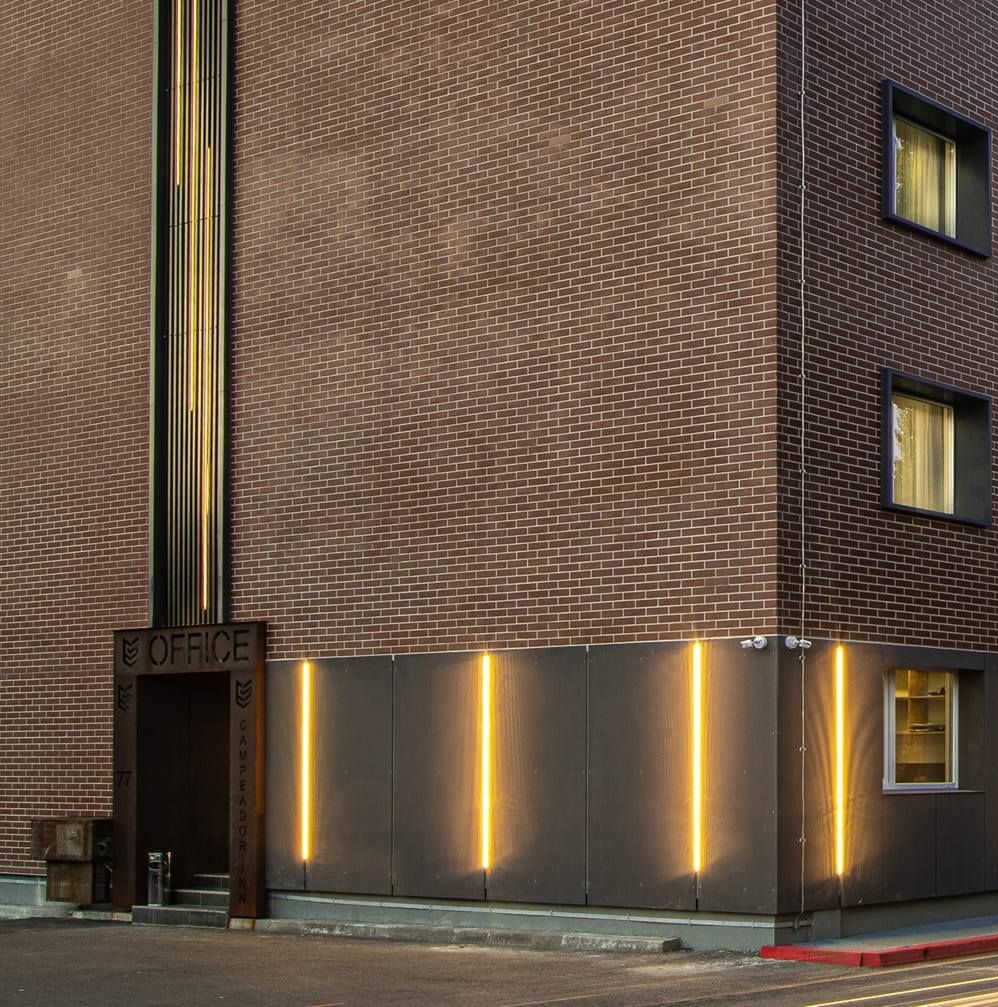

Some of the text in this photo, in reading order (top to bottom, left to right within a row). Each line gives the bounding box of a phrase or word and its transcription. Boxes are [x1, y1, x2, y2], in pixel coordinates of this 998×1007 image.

[150, 630, 249, 666] OFFICE
[116, 771, 132, 787] 77
[239, 720, 247, 851] CAMPEADOR
